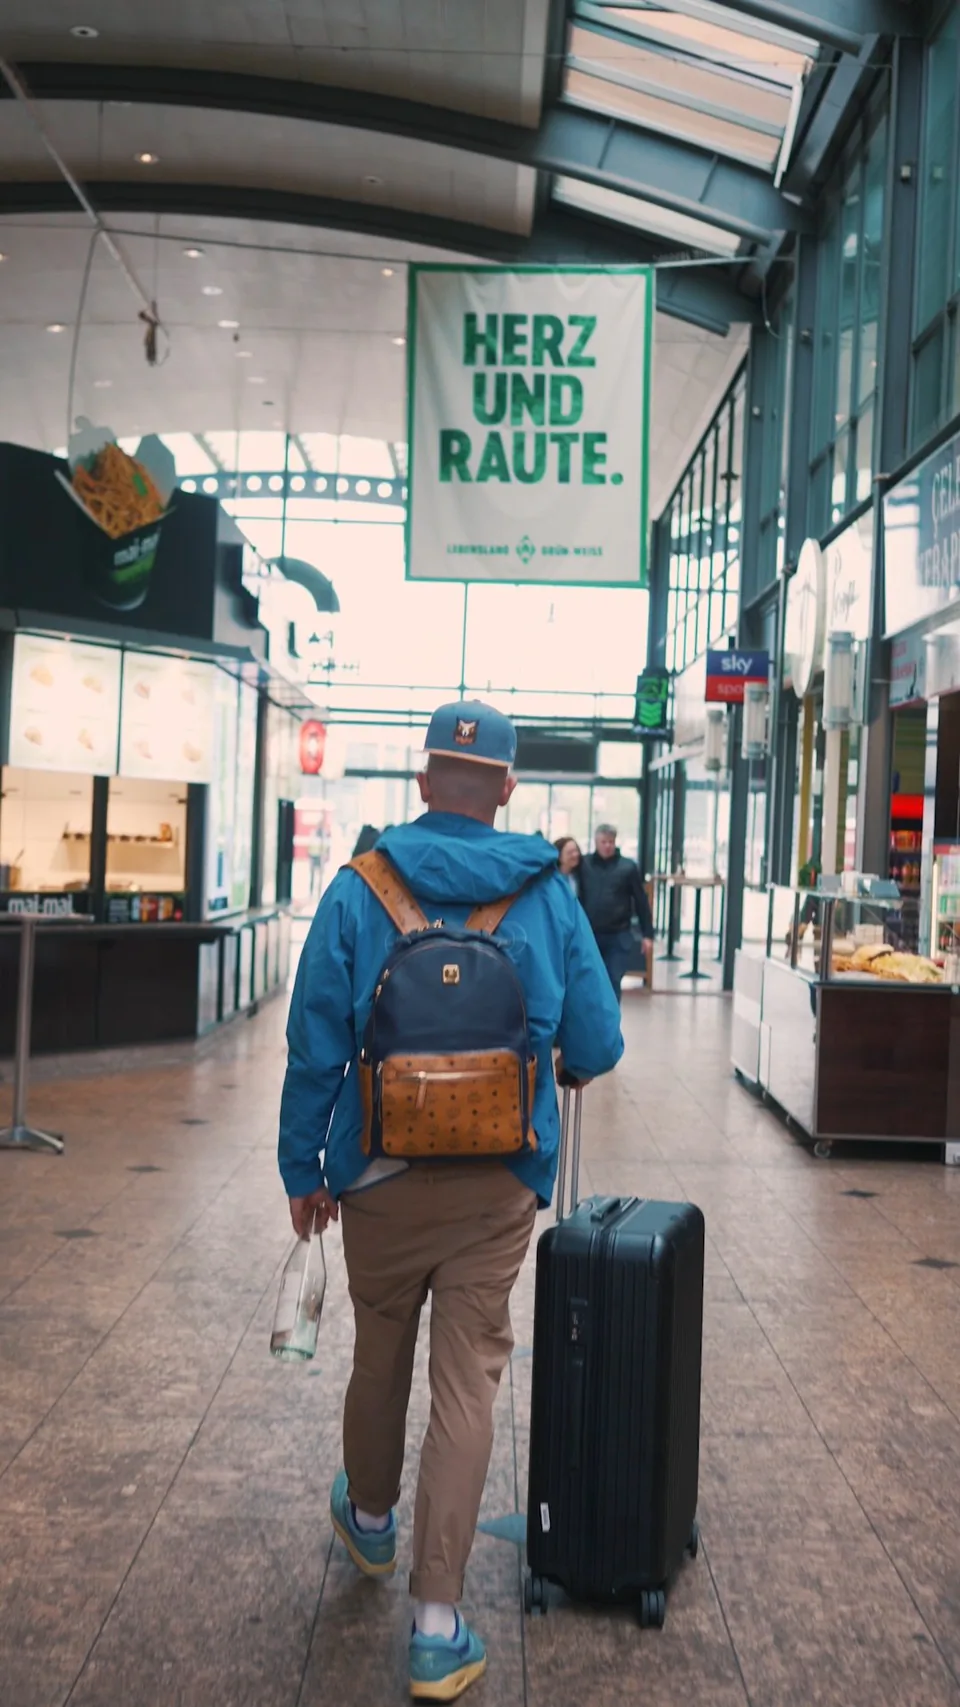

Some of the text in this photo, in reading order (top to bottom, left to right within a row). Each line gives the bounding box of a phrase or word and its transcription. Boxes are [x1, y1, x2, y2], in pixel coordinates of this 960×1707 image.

[463, 312, 597, 368] HERZ
[472, 372, 584, 427] UND
[438, 428, 623, 485] RAUTE.
[717, 683, 744, 696] spo
[721, 654, 753, 675] sky
